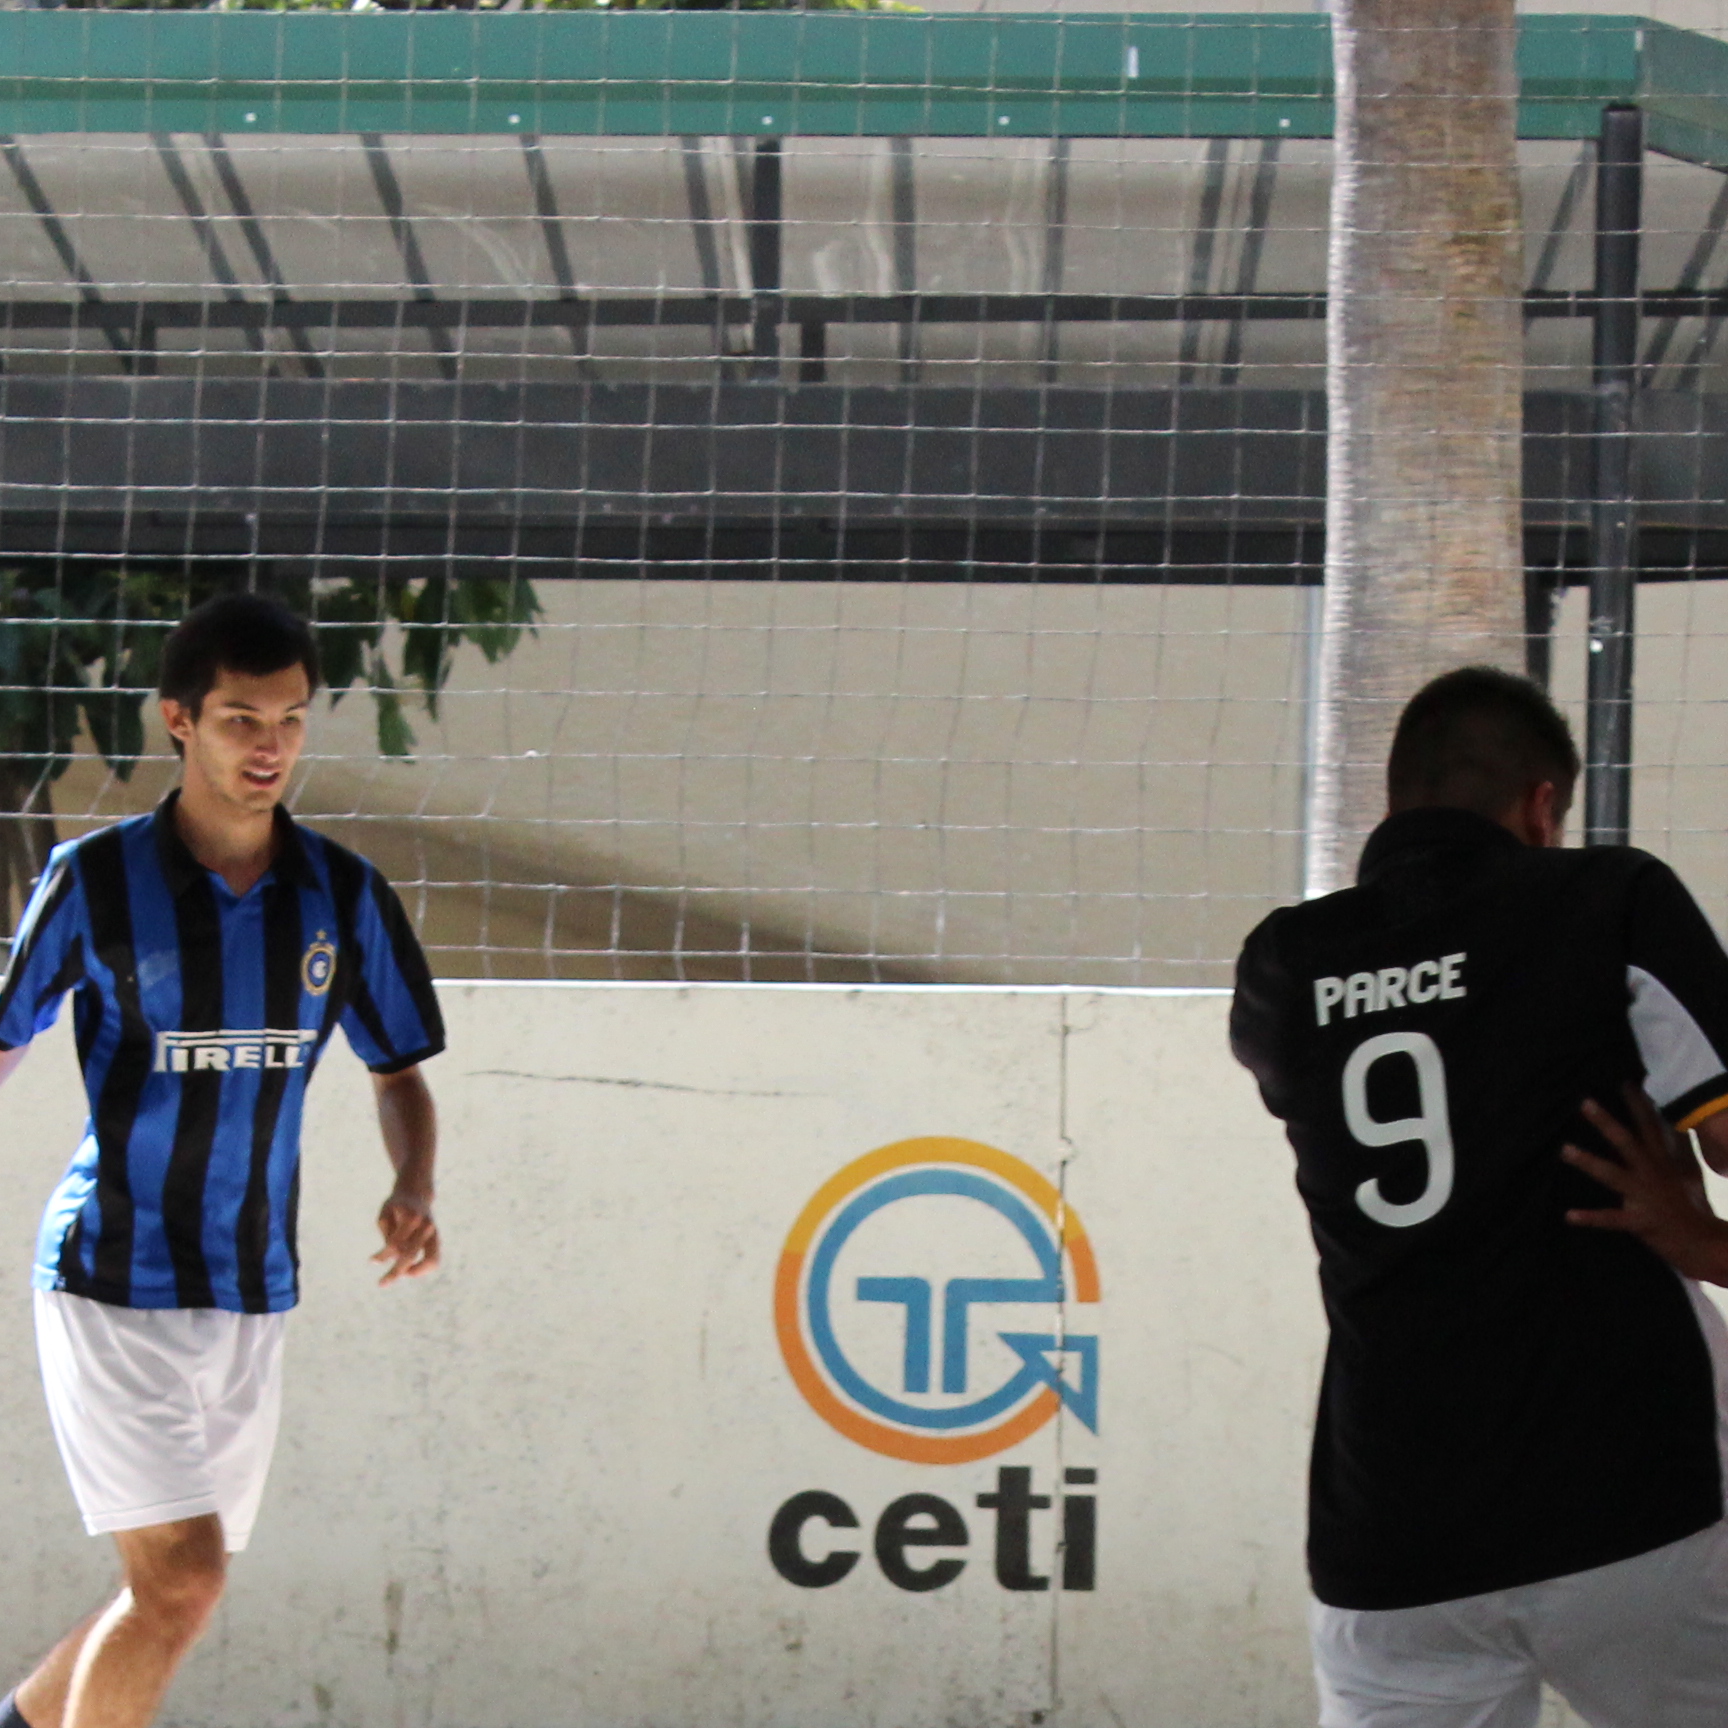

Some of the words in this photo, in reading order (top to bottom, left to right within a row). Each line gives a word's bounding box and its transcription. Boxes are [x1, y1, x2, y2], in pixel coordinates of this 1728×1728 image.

[1314, 952, 1467, 1027] PARCE
[153, 1028, 319, 1072] PIRELL
[1342, 1031, 1454, 1227] 9
[768, 1466, 1098, 1593] ceti
